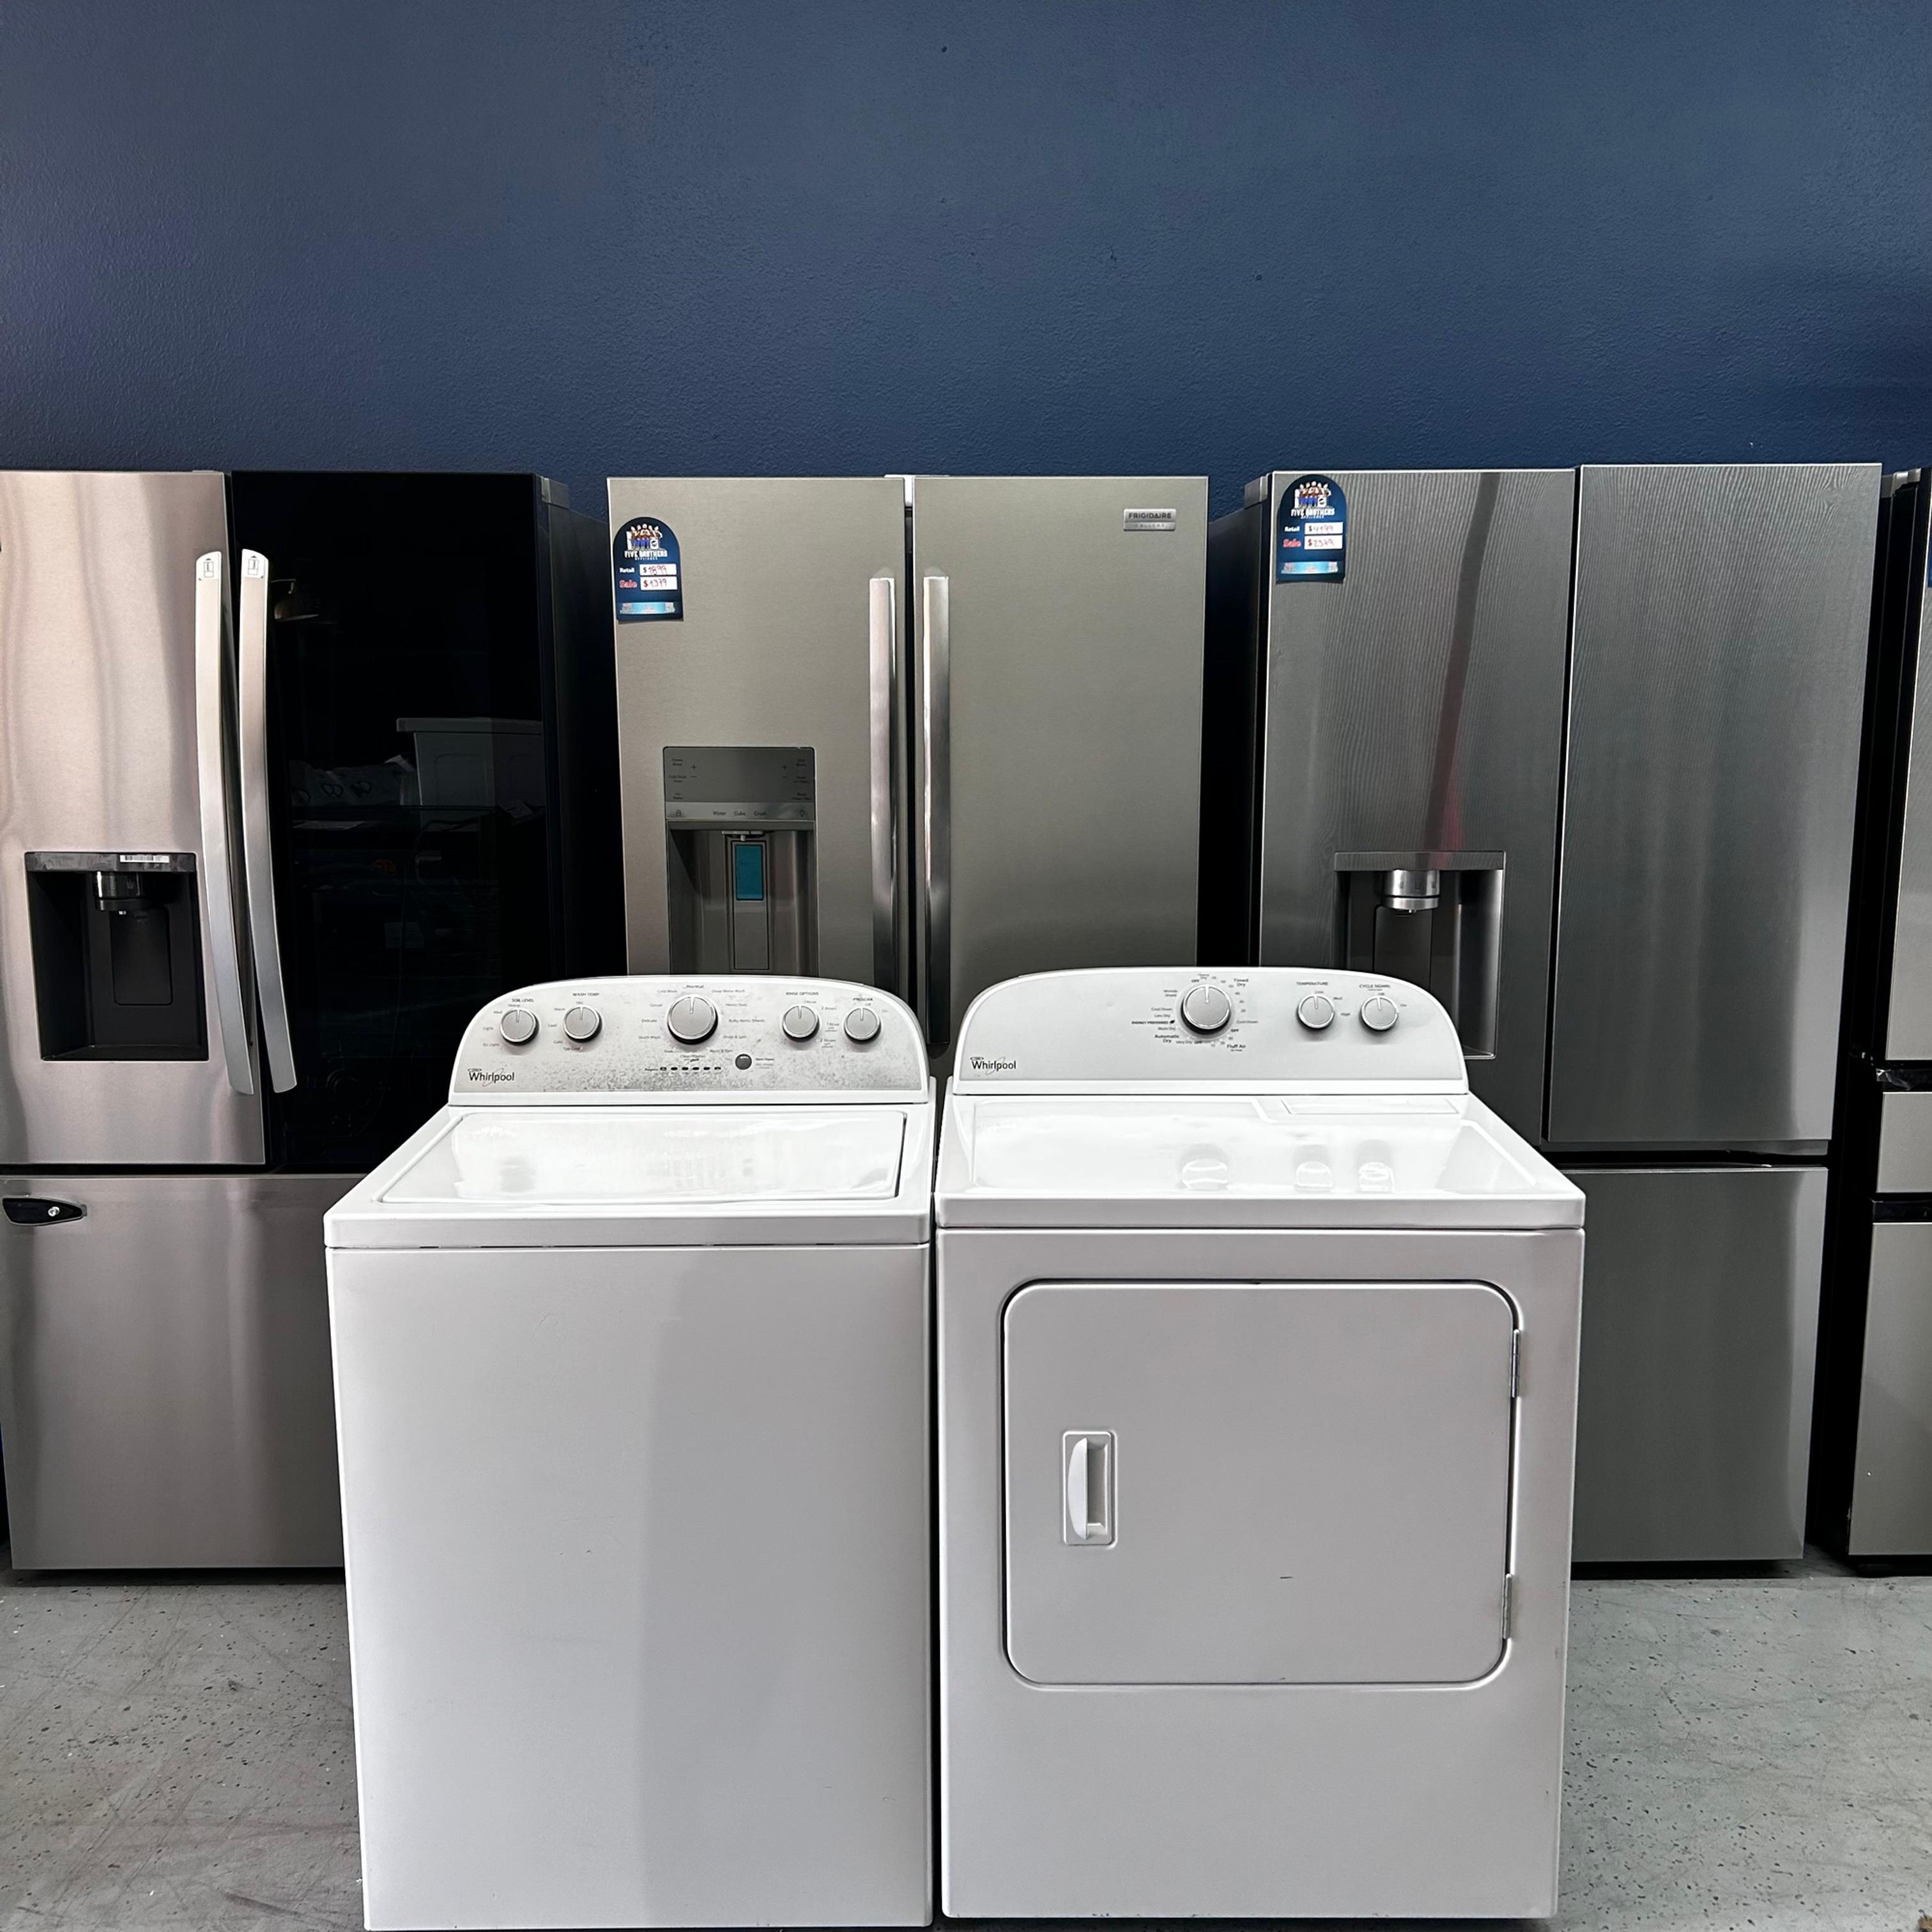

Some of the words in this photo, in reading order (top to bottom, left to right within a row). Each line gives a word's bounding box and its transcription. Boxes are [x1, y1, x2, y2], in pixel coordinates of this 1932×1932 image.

[1305, 508, 1335, 516] BROTHERS
[640, 549, 668, 558] BROTHERS
[970, 1060, 1016, 1072] Whirlpool
[468, 1071, 515, 1084] Whirlpool
